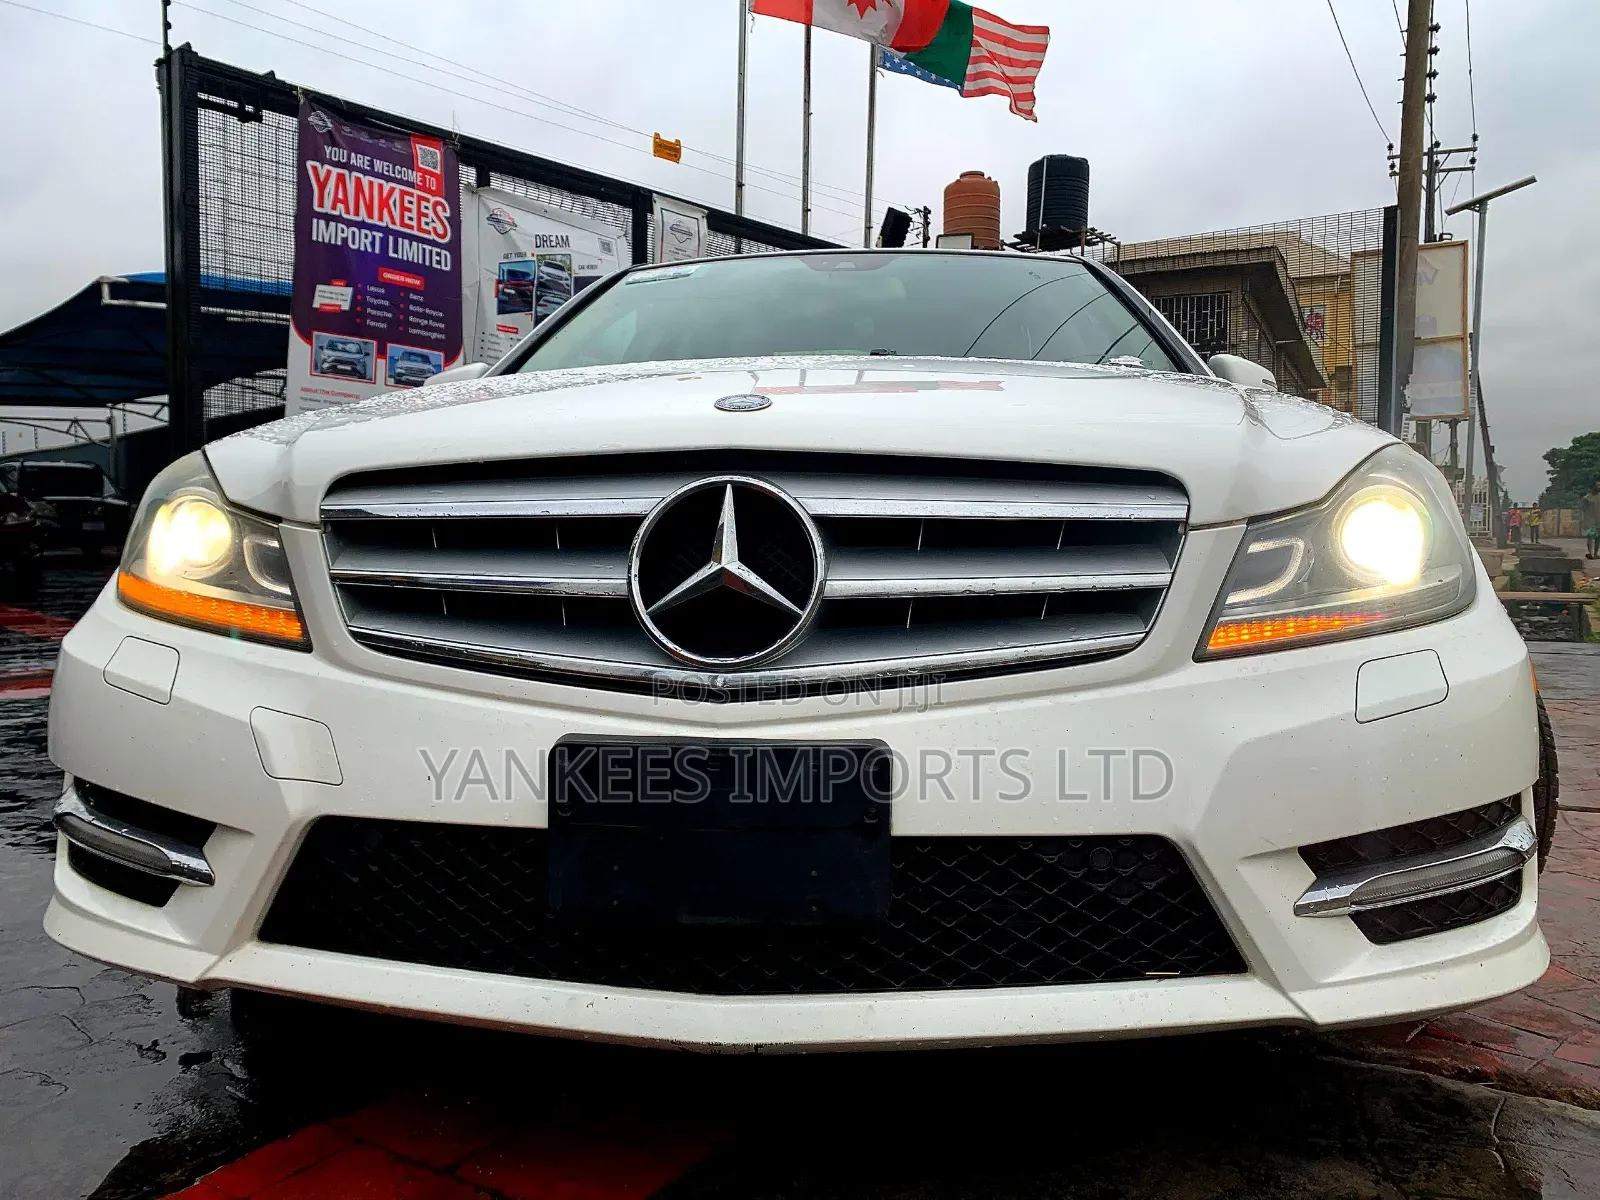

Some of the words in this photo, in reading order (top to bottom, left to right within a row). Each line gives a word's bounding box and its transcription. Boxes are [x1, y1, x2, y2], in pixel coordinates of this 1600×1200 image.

[324, 145, 347, 163] YOU
[350, 154, 370, 170] ARE
[374, 158, 423, 186] WELCOME
[425, 174, 437, 190] TO
[306, 160, 451, 243] YANKEES
[312, 217, 384, 254] IMPORT
[388, 235, 451, 271] LIMITED
[535, 234, 571, 248] DREAM
[366, 295, 390, 307] Toyota
